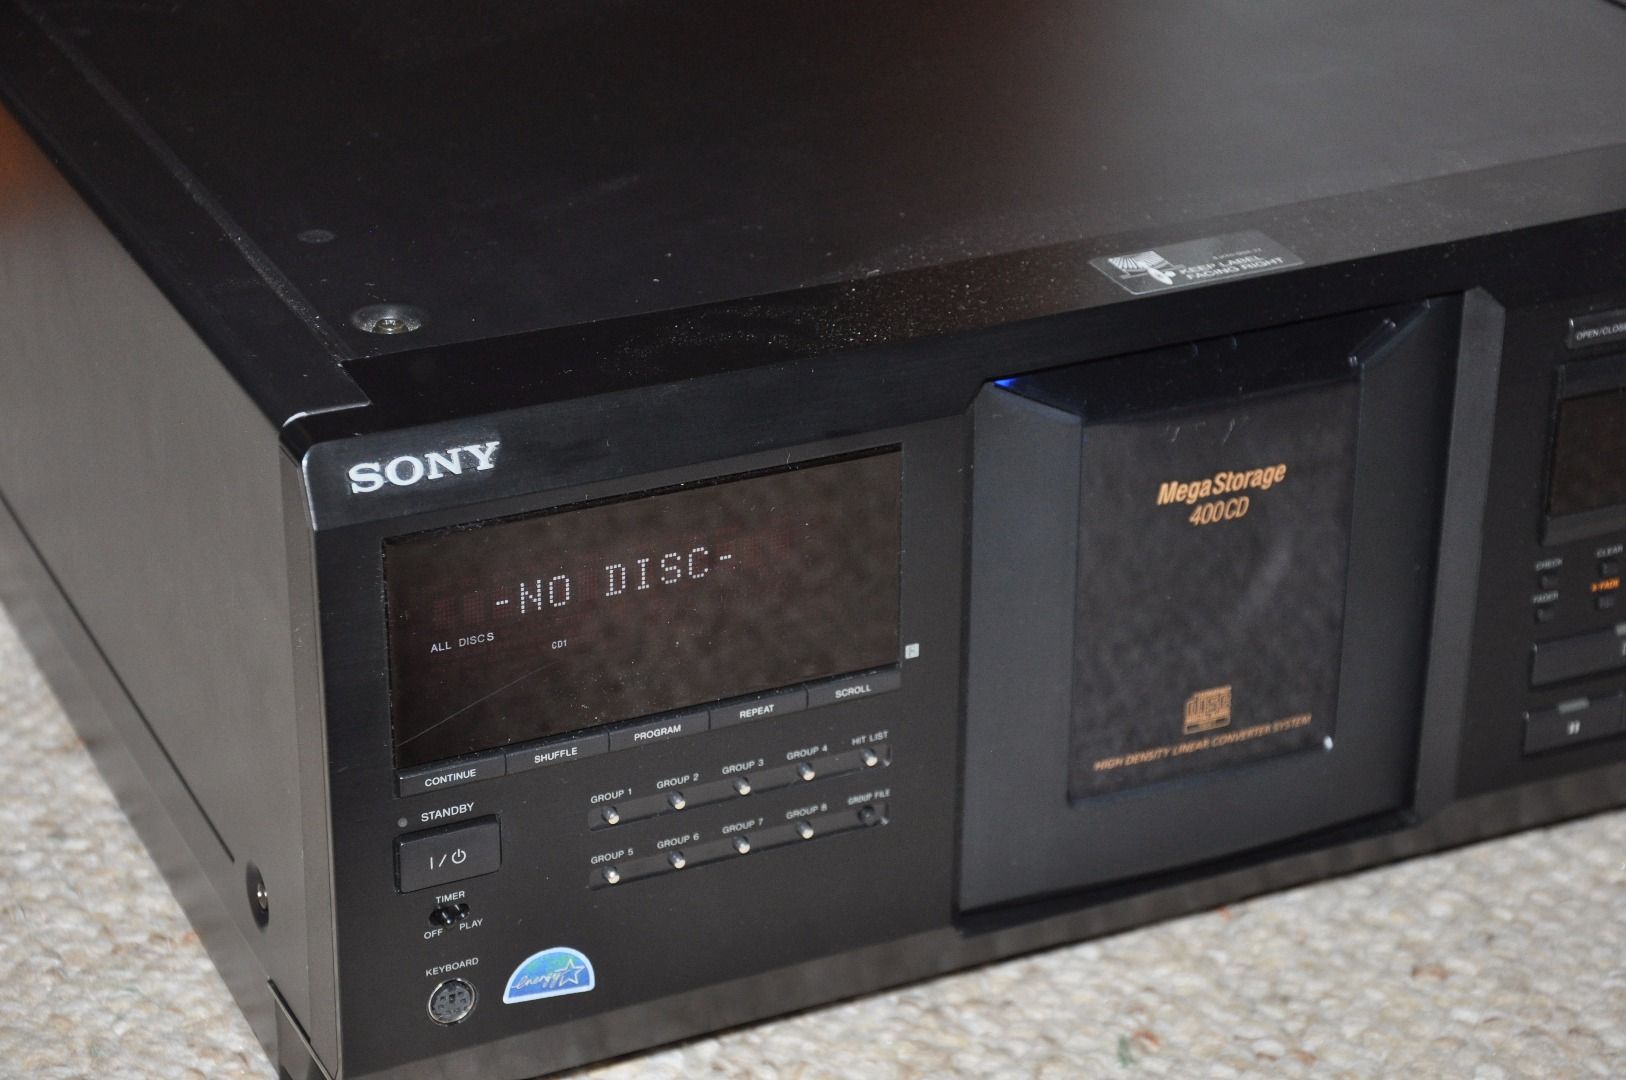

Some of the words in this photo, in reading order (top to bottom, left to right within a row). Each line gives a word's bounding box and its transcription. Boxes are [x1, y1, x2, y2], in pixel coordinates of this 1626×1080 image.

[348, 441, 500, 494] SONY
[430, 641, 452, 653] ALL
[458, 632, 495, 647] DISCS
[551, 639, 568, 650] CD1
[835, 684, 872, 699] SCROLL
[739, 704, 775, 720] REPEAT
[634, 724, 682, 741] PROGRAM
[852, 733, 867, 746] HIT
[869, 730, 889, 743] LIST
[534, 747, 578, 764] SHUFFLE
[786, 746, 820, 761] GROUP
[821, 744, 828, 753] 4
[721, 760, 755, 775] GROUP
[757, 758, 764, 768] 3
[424, 768, 477, 787] CONTINUE
[656, 775, 690, 789] GROUP
[693, 772, 699, 782] 2
[590, 789, 625, 804] GROUP
[421, 802, 475, 822] STANDBY
[785, 804, 819, 820] GROUP
[721, 819, 755, 835] GROUP
[757, 817, 764, 827] 7
[656, 834, 691, 849] GROUP
[692, 832, 700, 842] 6
[590, 849, 625, 865] GROUP
[627, 848, 634, 857] 5
[436, 890, 465, 904] TIMER
[423, 928, 443, 940] OFF
[459, 918, 483, 931] PLAY
[425, 957, 479, 977] KEYBOARD
